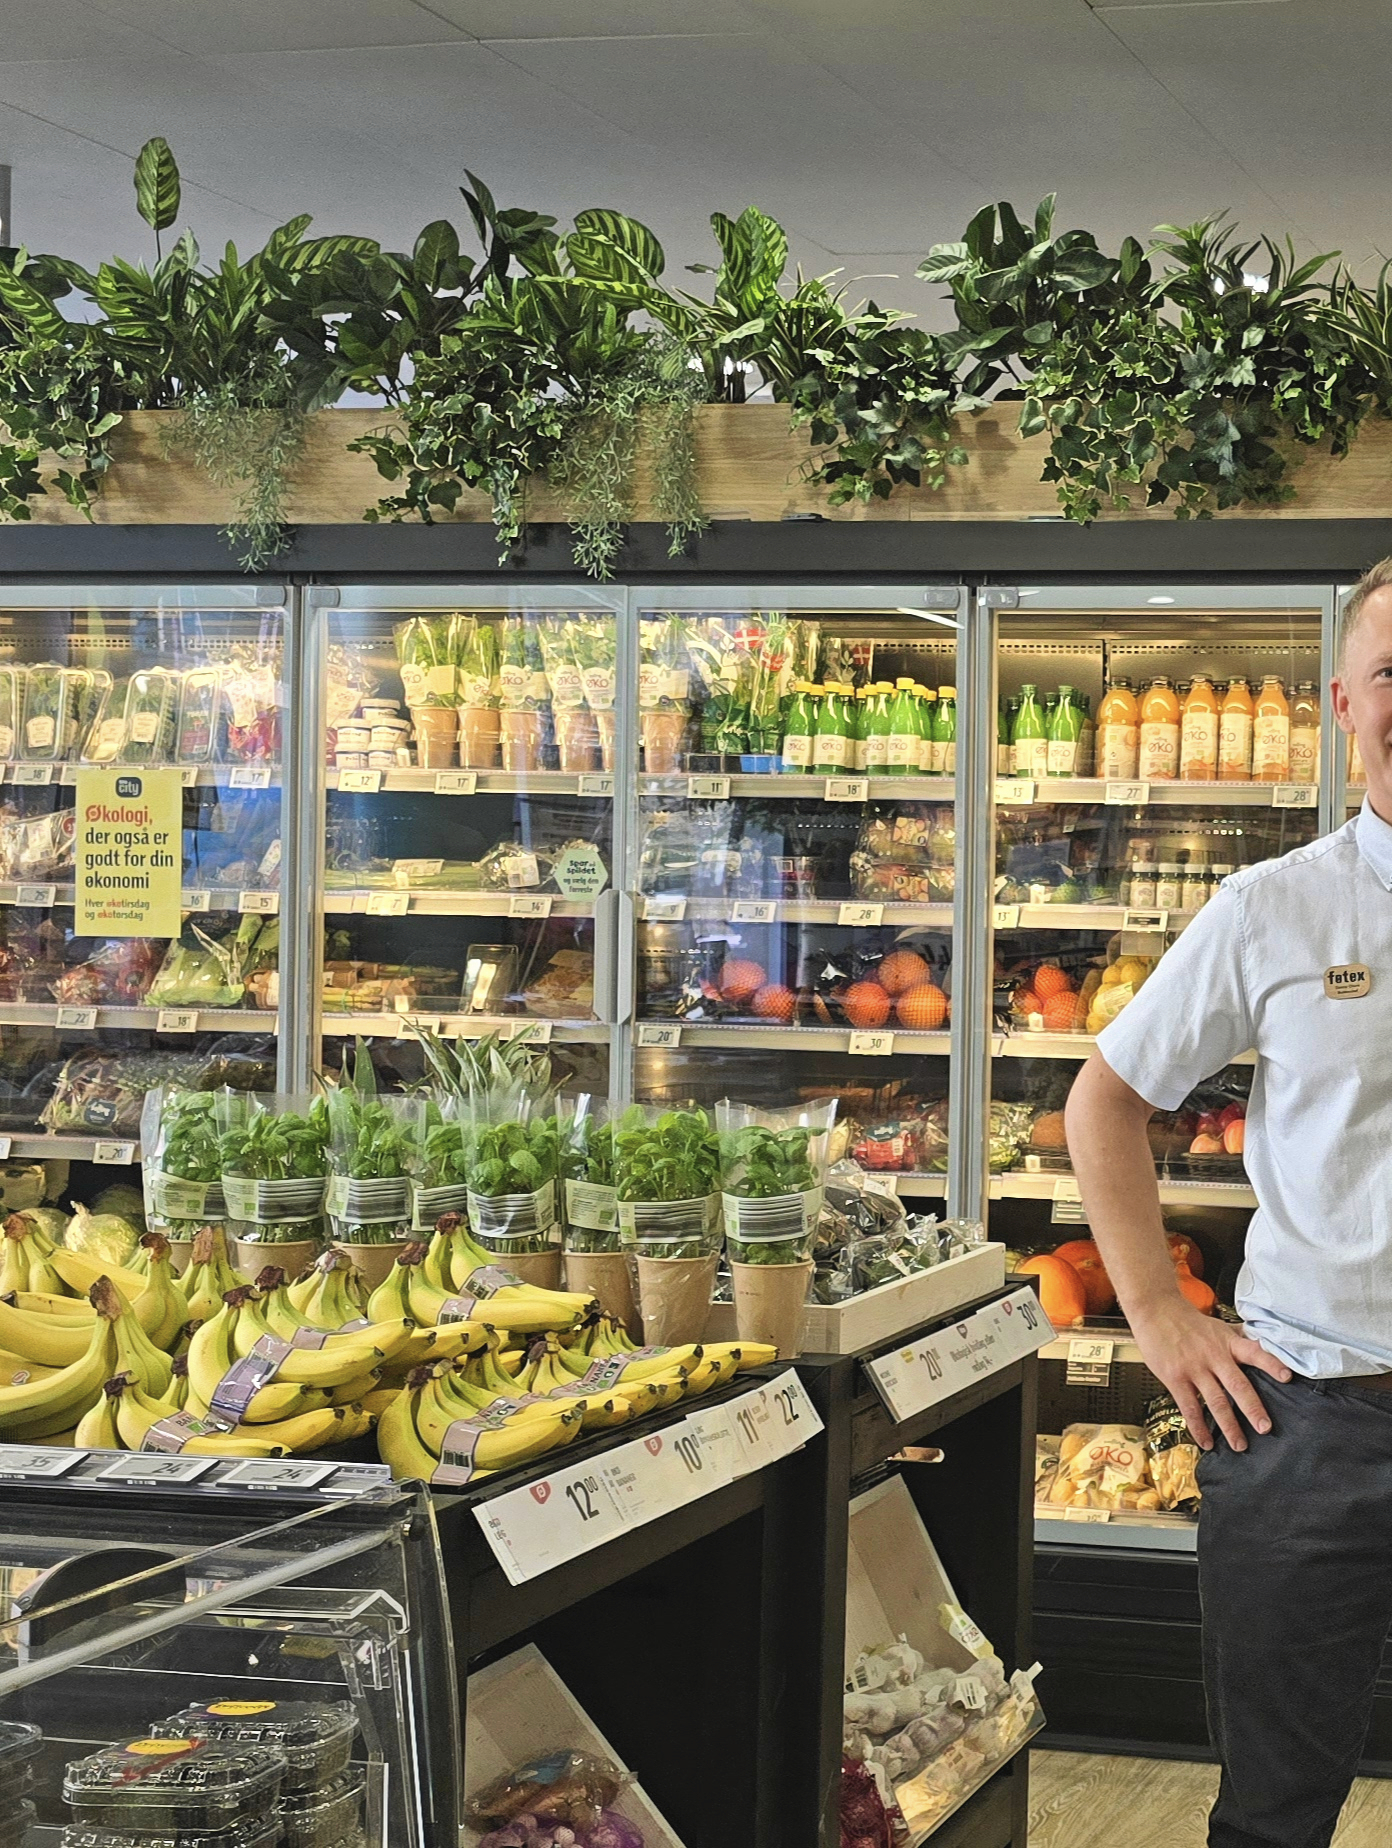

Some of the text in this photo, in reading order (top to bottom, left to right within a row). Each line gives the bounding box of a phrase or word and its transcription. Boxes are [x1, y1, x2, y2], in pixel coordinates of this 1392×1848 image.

[85, 805, 153, 827] Økologi,
[85, 827, 169, 848] der også er
[85, 849, 174, 870] godt for din
[85, 871, 150, 889] økonomi
[85, 910, 95, 920] og
[1089, 1444, 1134, 1467] ØKO
